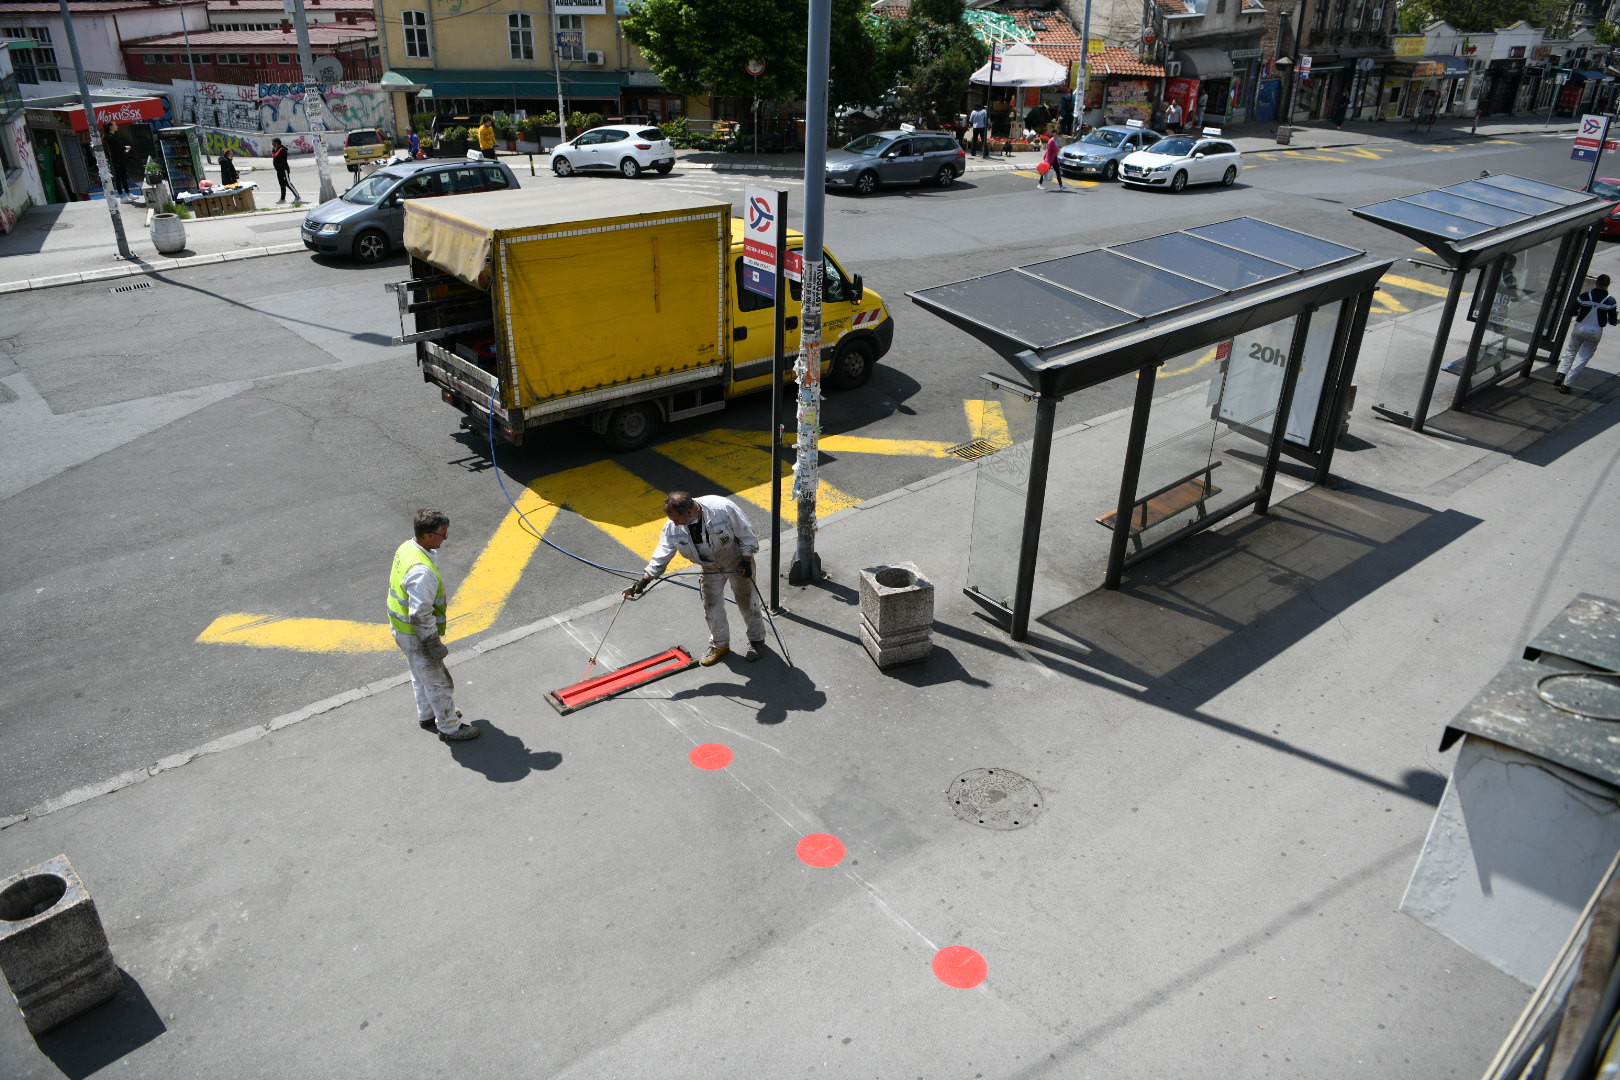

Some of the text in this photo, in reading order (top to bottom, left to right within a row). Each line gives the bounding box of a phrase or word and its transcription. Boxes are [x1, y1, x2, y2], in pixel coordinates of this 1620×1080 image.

[112, 107, 142, 121] KIOSK
[794, 258, 799, 270] 1
[1248, 342, 1287, 368] 20h
